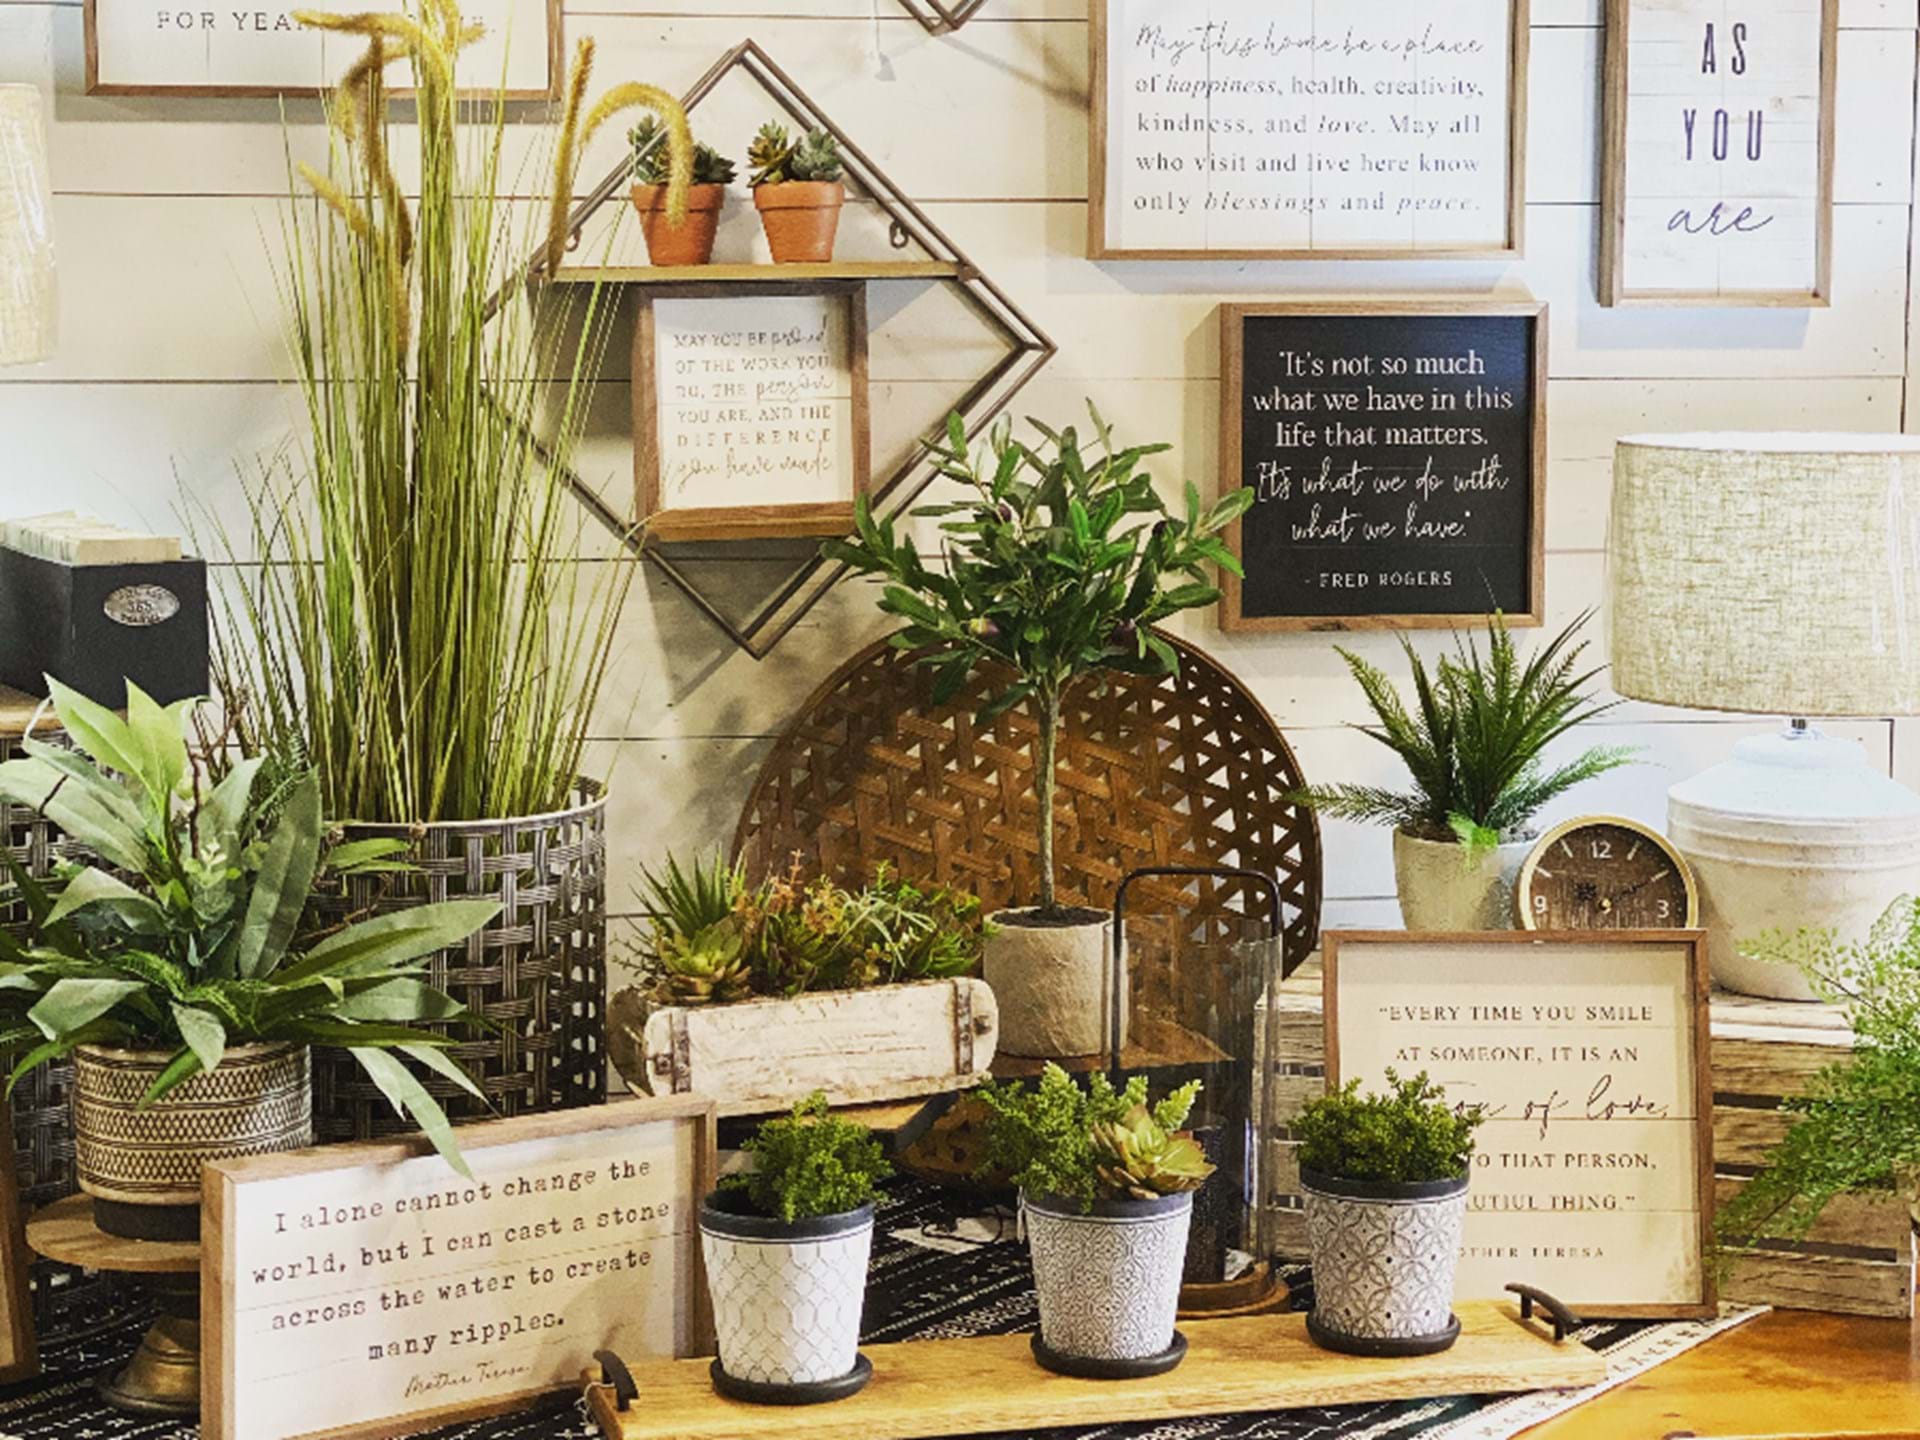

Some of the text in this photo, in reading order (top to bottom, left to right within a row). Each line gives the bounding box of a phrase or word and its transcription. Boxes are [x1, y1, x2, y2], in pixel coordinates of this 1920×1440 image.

[157, 11, 304, 31] FOR YEA
[1135, 23, 1194, 67] May
[1188, 20, 1260, 58] this
[1264, 21, 1338, 56] home
[1343, 25, 1376, 56] be
[1401, 22, 1485, 62] place
[1701, 22, 1747, 76] AS
[1135, 73, 1162, 93] of
[1165, 74, 1284, 100] happiness,
[1373, 75, 1484, 100] creativity,
[1137, 112, 1481, 139] kindness, and love. May all
[1682, 108, 1763, 162] YOU
[1136, 153, 1481, 173] who visit and live here know
[1133, 191, 1481, 216] only blessings and peace.
[1666, 201, 1775, 236] are
[673, 333, 708, 348] MAY
[711, 332, 743, 348] YOU
[748, 331, 767, 347] BE
[674, 355, 831, 375] OF THE WORK YOU
[1331, 354, 1374, 376] not
[1380, 355, 1408, 375] so
[1414, 350, 1486, 376] much
[713, 383, 748, 398] THE
[1252, 385, 1514, 412] what we have in this
[677, 405, 832, 424] YOU ARE, AND THE
[676, 428, 832, 447] DIFFERENCE
[1274, 421, 1489, 447] life that matters.
[1255, 453, 1510, 503] It's what we do with
[1291, 502, 1363, 543] what
[1361, 523, 1396, 541] we
[1319, 572, 1370, 588] FRED
[1378, 570, 1453, 587] ROGERS
[1590, 841, 1613, 859] 12
[1533, 895, 1548, 915] 9
[1656, 899, 1670, 919] 3
[1378, 1005, 1653, 1022] "EVERY TIME YOU SMILE
[1395, 1046, 1639, 1065] AT SOMEONE, IT IS AN
[1523, 1089, 1569, 1141] of
[1499, 1152, 1556, 1169] THAT
[1563, 1152, 1657, 1170] PERSON,
[274, 1159, 651, 1234] I alone cannot change the
[252, 1199, 671, 1285] world, but I can cast a stone
[1459, 1246, 1604, 1259] OTHER TERESA
[271, 1247, 652, 1331] across the water to create
[367, 1312, 565, 1362] many ripples.
[404, 1372, 473, 1398] Mother
